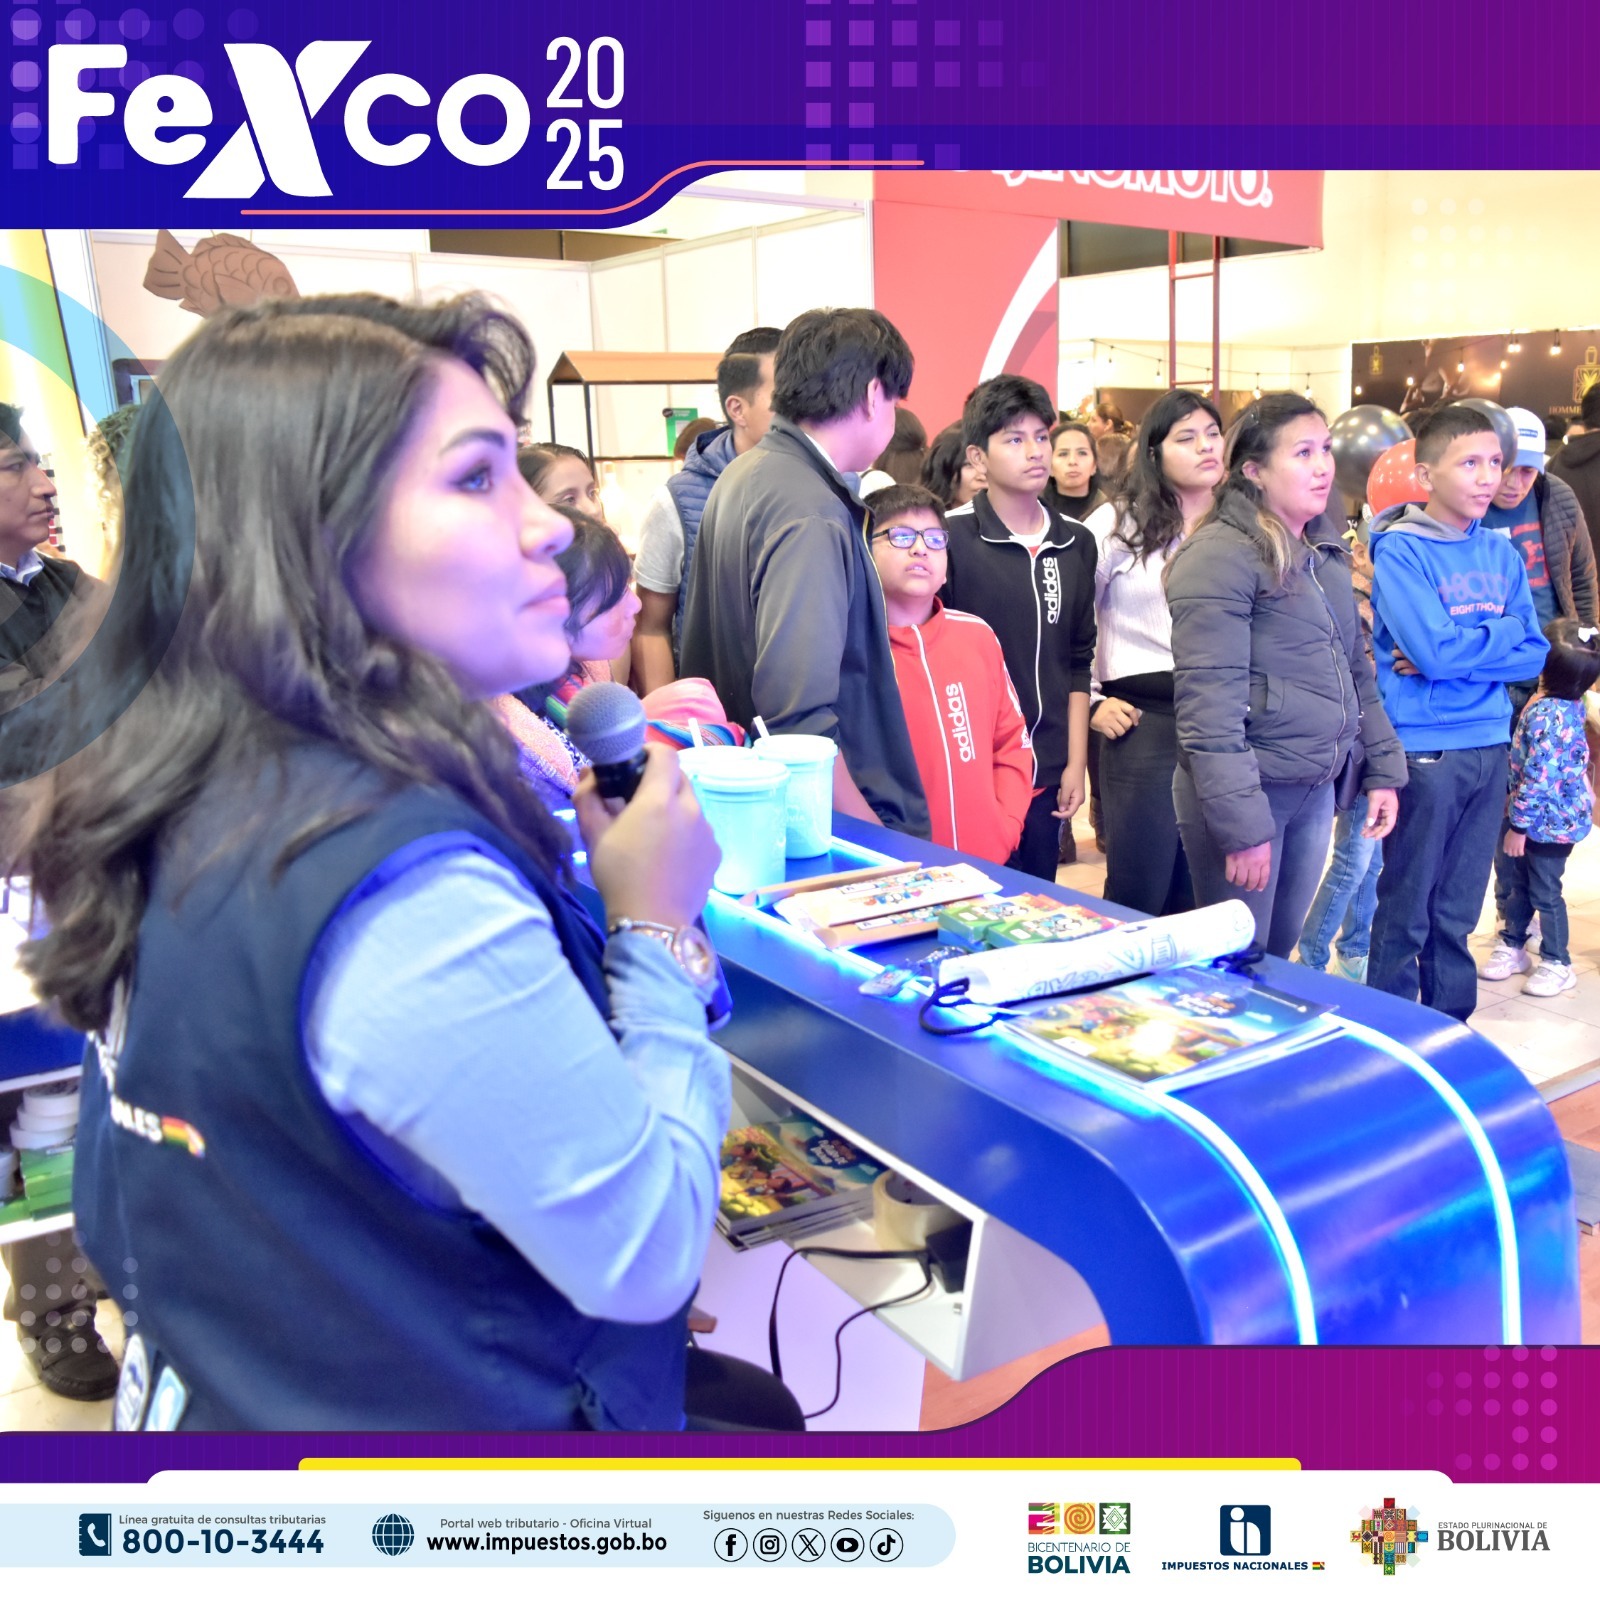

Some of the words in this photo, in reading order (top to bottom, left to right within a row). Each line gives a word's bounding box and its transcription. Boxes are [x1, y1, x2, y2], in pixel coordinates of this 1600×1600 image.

[1042, 557, 1058, 624] adidas
[1450, 603, 1475, 615] EIGHT
[946, 683, 972, 762] adidas
